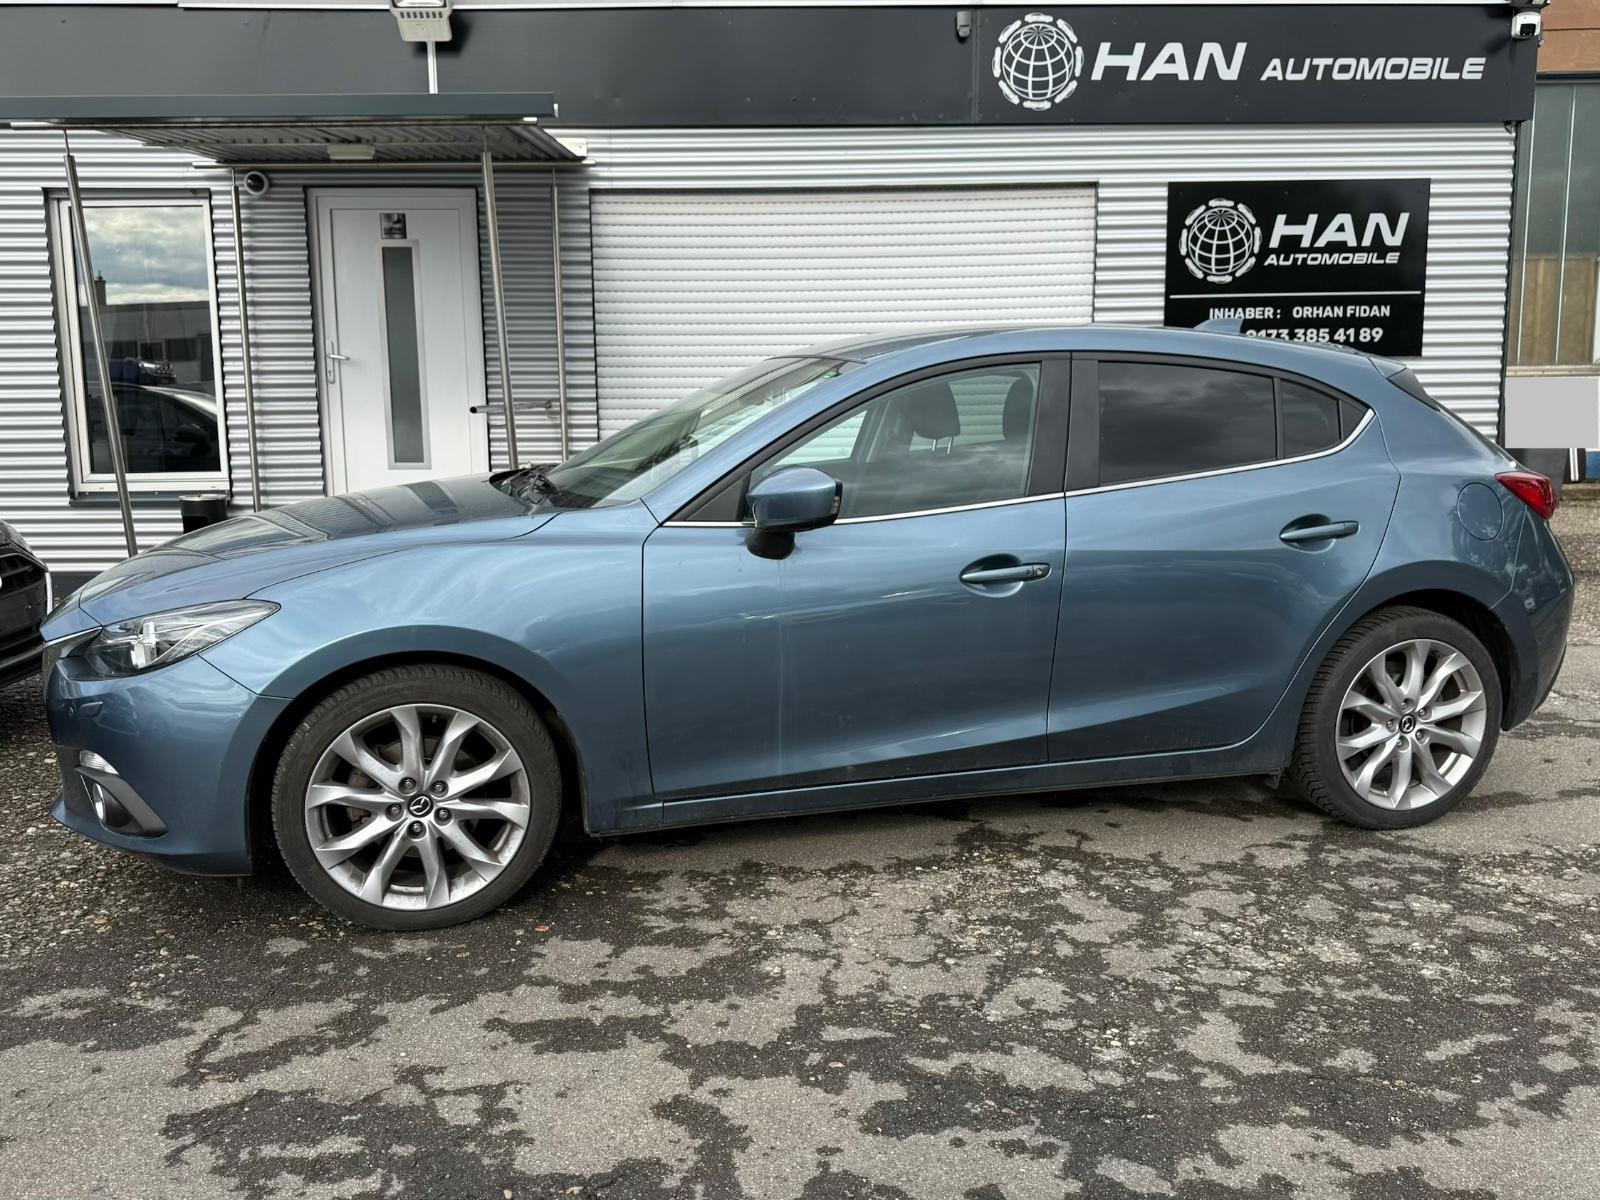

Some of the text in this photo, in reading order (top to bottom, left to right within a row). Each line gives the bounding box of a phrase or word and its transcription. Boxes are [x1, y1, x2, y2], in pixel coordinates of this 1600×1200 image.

[1090, 41, 1486, 82] HAN AUTOMOBILE
[1268, 212, 1410, 249] HAN
[1264, 252, 1401, 267] AUTOMOBILE
[1292, 306, 1344, 319] ORHAN
[1347, 305, 1391, 318] FIDAN
[1293, 328, 1330, 343] 385
[1333, 328, 1355, 343] 41
[1358, 327, 1384, 342] 89
